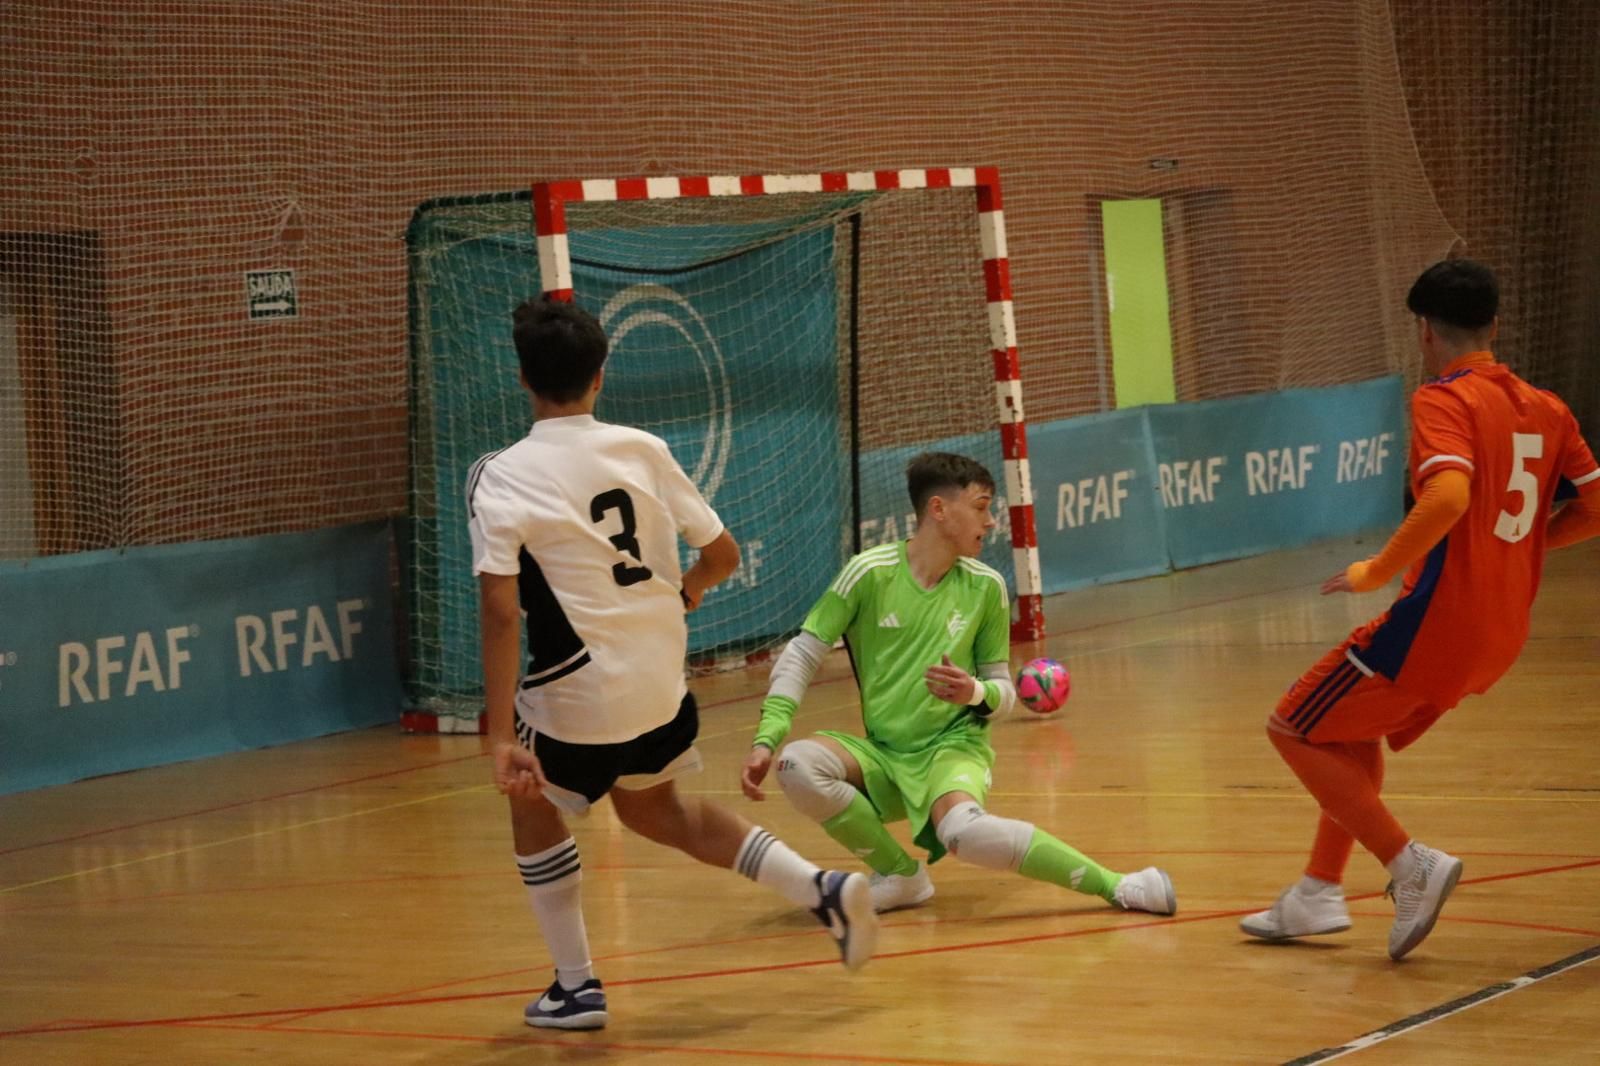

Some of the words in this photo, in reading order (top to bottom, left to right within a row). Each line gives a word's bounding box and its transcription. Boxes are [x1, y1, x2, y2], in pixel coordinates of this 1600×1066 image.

[1056, 470, 1129, 530] RFAF
[1157, 455, 1222, 508] RFAF
[1245, 445, 1315, 496] RFAF
[1336, 433, 1389, 483] RFAF
[1493, 432, 1543, 543] 5
[590, 488, 653, 587] 3
